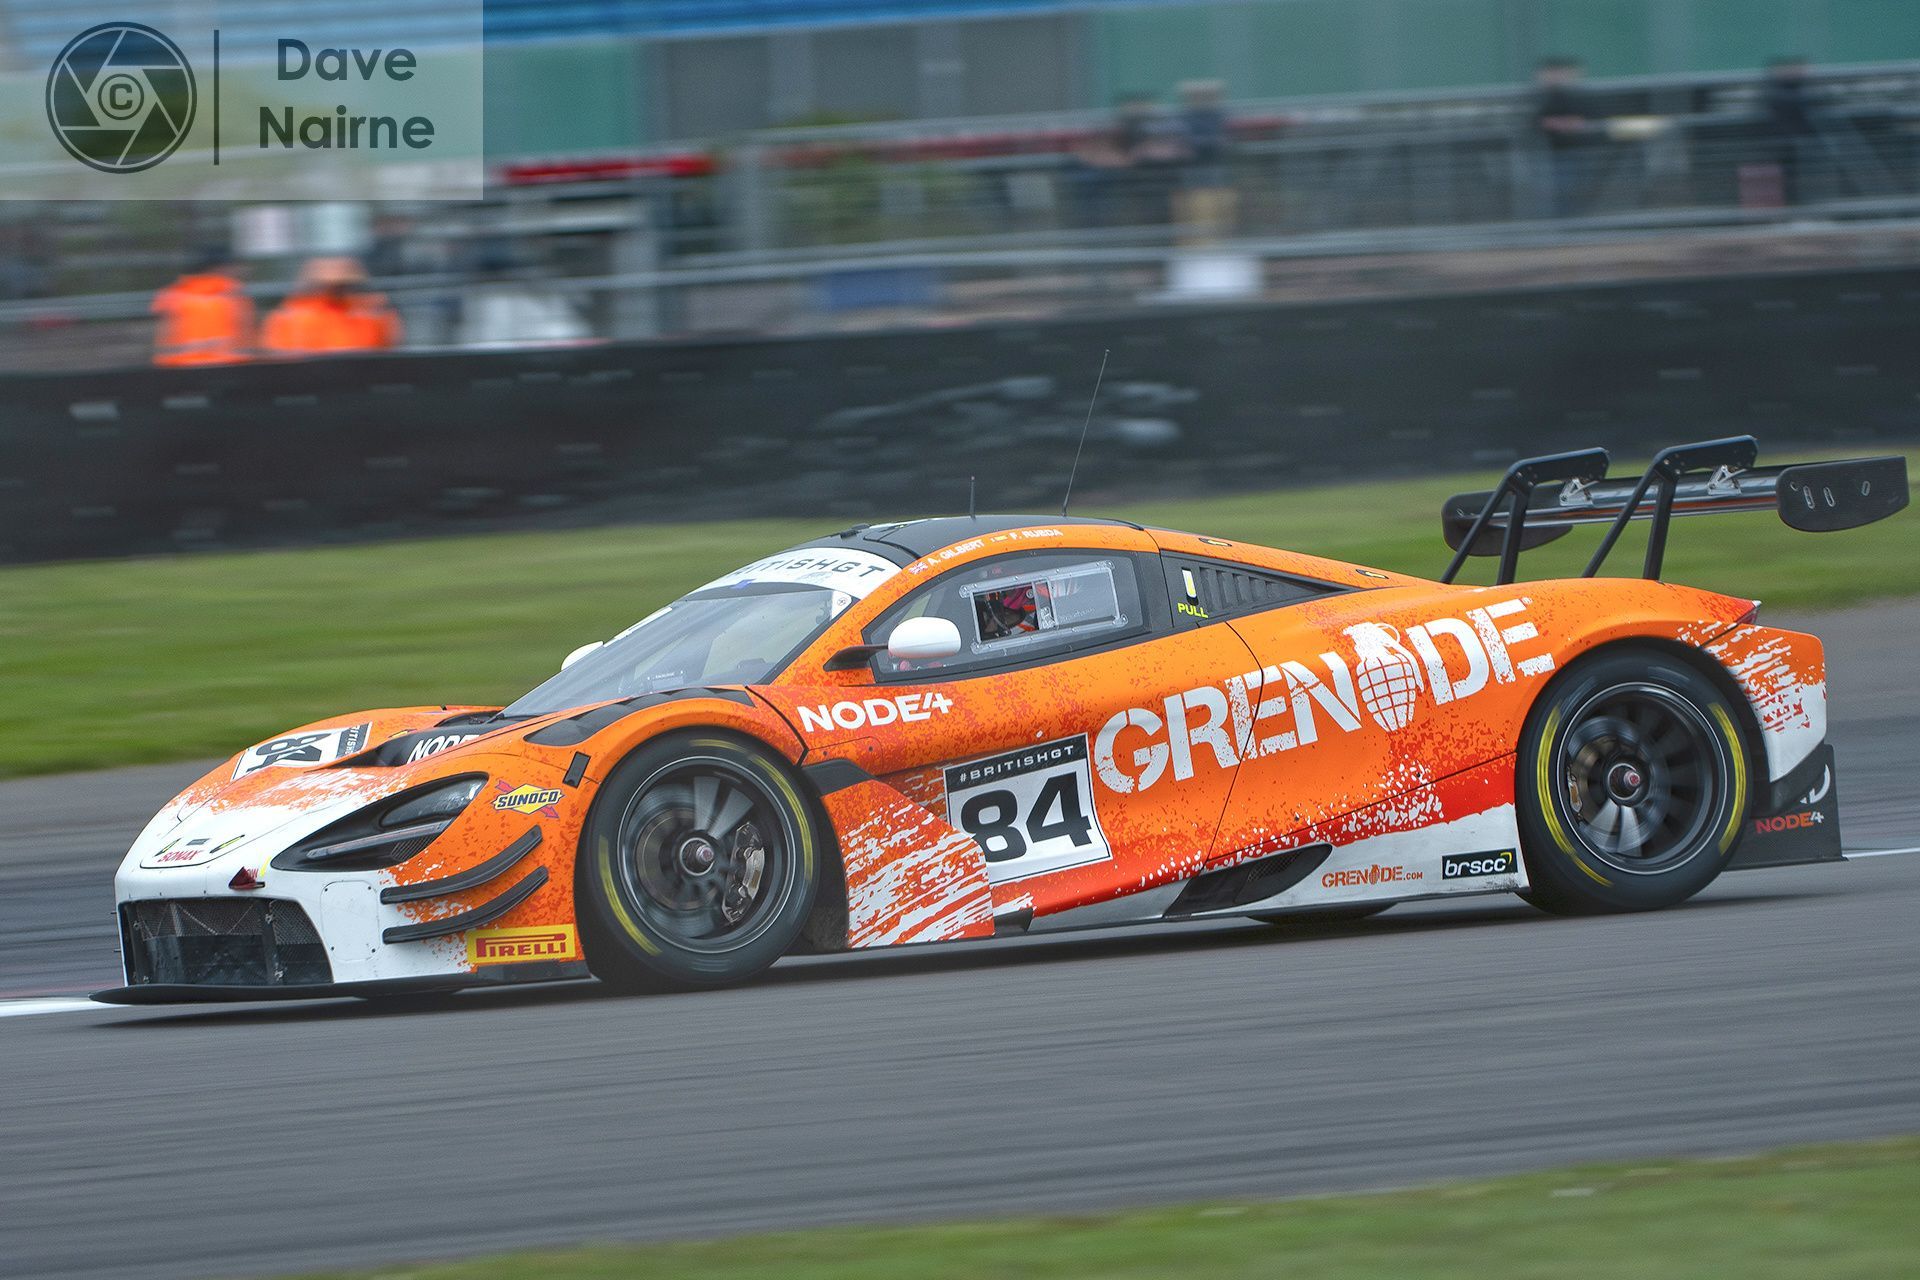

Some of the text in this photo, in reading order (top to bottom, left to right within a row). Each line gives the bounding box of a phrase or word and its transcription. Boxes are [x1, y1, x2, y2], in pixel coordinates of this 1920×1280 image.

[940, 539, 985, 560] GILBERT
[1177, 602, 1209, 618] PULL
[796, 692, 954, 733] NODE4
[959, 745, 1074, 783] #BRITISHGT
[497, 791, 559, 808] SUNOCO
[960, 771, 1093, 863] 84
[1755, 811, 1825, 834] NODE4
[1444, 857, 1507, 877] brscc
[476, 932, 567, 958] PIRELLI
